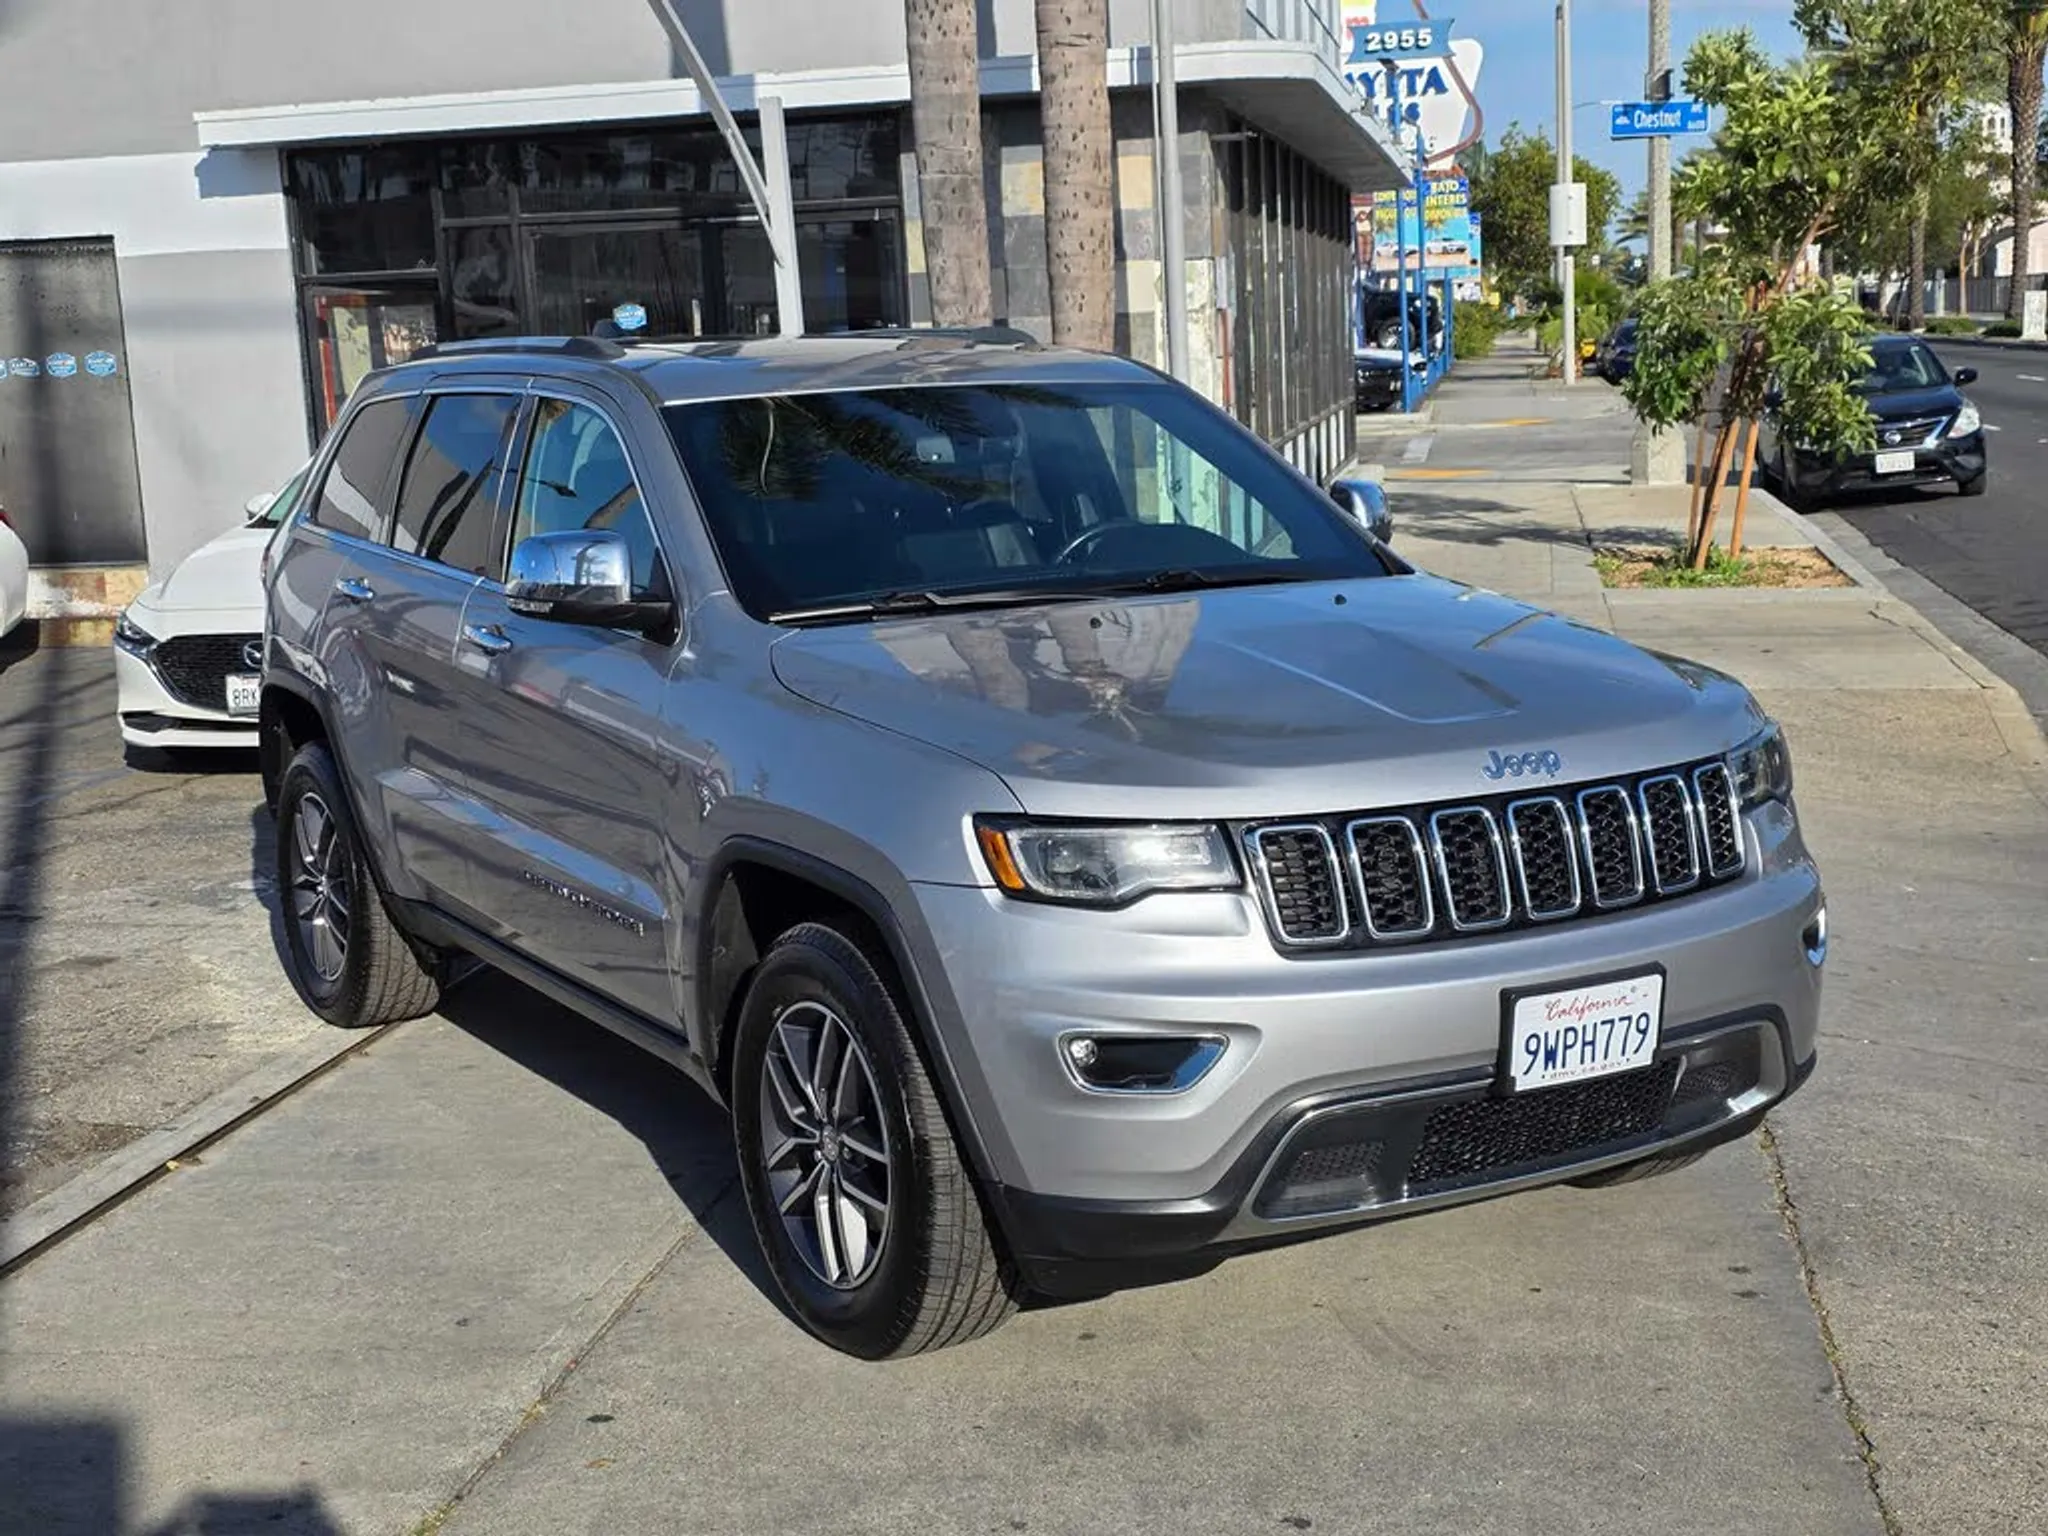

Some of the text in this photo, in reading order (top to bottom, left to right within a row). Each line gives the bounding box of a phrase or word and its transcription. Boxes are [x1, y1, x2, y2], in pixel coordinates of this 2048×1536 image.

[1365, 27, 1433, 54] 2955
[1634, 109, 1681, 129] Chestnut
[1482, 750, 1561, 779] Jeep
[1544, 995, 1635, 1022] California
[1523, 1012, 1651, 1076] 9WPH779
